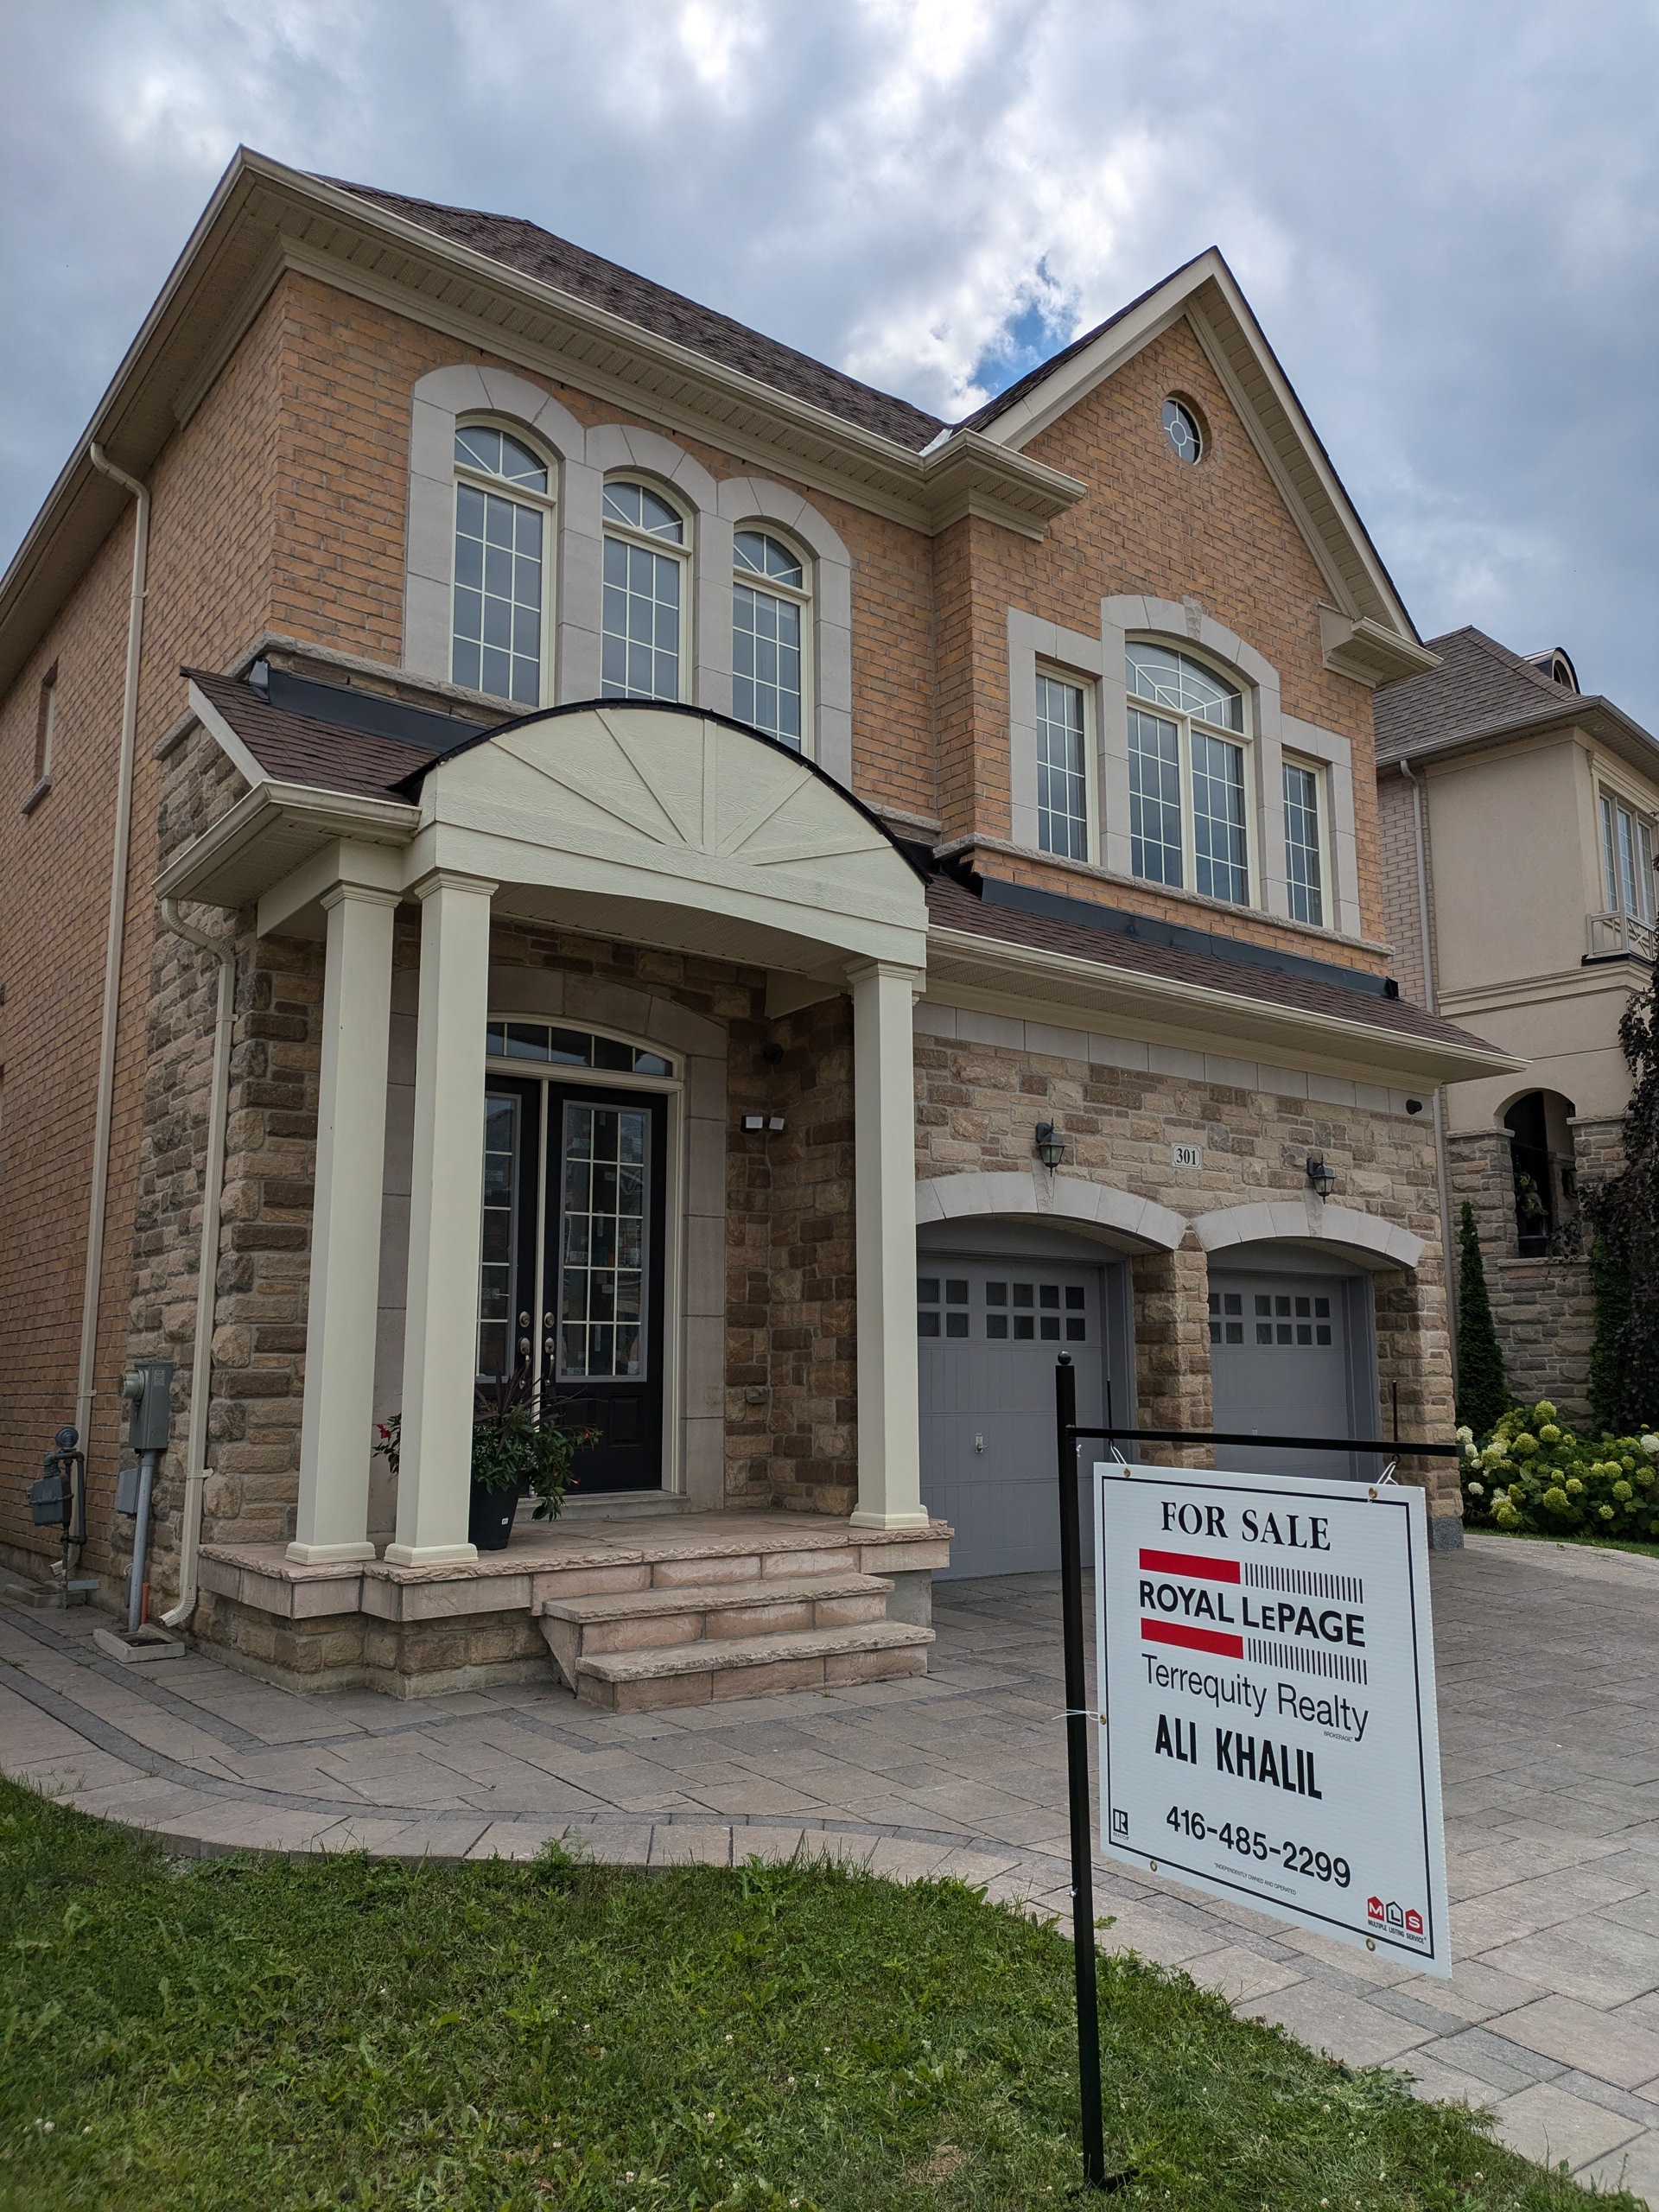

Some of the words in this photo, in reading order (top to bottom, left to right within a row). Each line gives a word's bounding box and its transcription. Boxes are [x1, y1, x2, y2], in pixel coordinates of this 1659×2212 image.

[1176, 1147, 1197, 1165] 301
[1160, 1501, 1228, 1539] FOR
[1241, 1510, 1331, 1551] SALE
[1140, 1580, 1234, 1624] ROYAL
[1141, 1653, 1268, 1718] Terrequity
[1277, 1682, 1369, 1742] Realty
[1154, 1713, 1197, 1765] ALI
[1216, 1727, 1323, 1800] KHALIL
[1166, 1805, 1351, 1888] 416-485-2299
[1248, 1873, 1264, 1884] OWNED
[1274, 1883, 1297, 1896] OPERATED
[1367, 1918, 1388, 1932] MULTIPLE
[1389, 1926, 1405, 1937] LISTING
